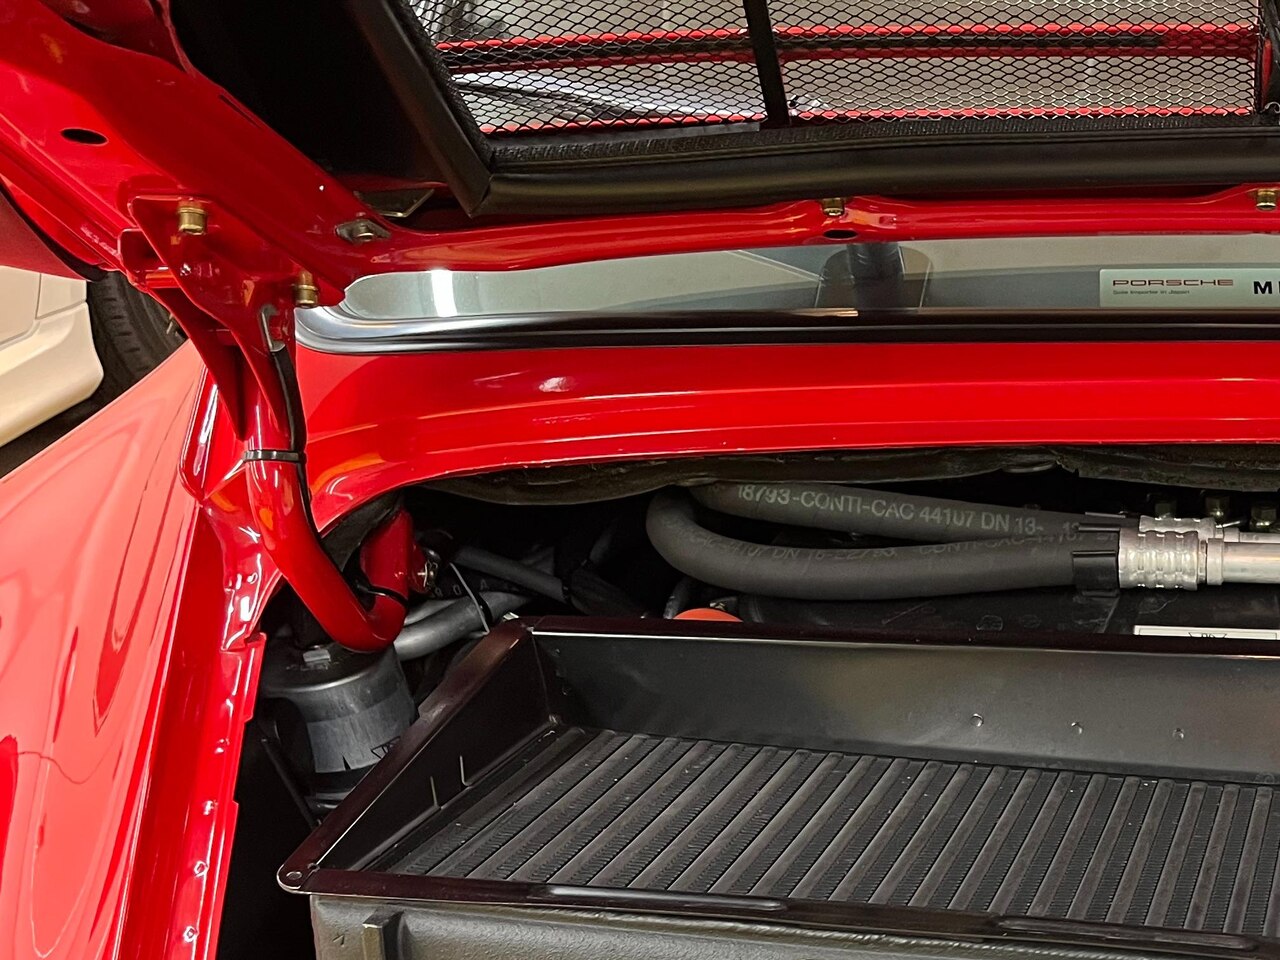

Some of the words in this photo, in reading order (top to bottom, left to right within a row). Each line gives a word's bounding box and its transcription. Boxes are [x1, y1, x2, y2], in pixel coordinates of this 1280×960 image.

[1112, 279, 1234, 287] PORSCHE
[919, 505, 975, 527] 44107
[981, 512, 1010, 534] DN
